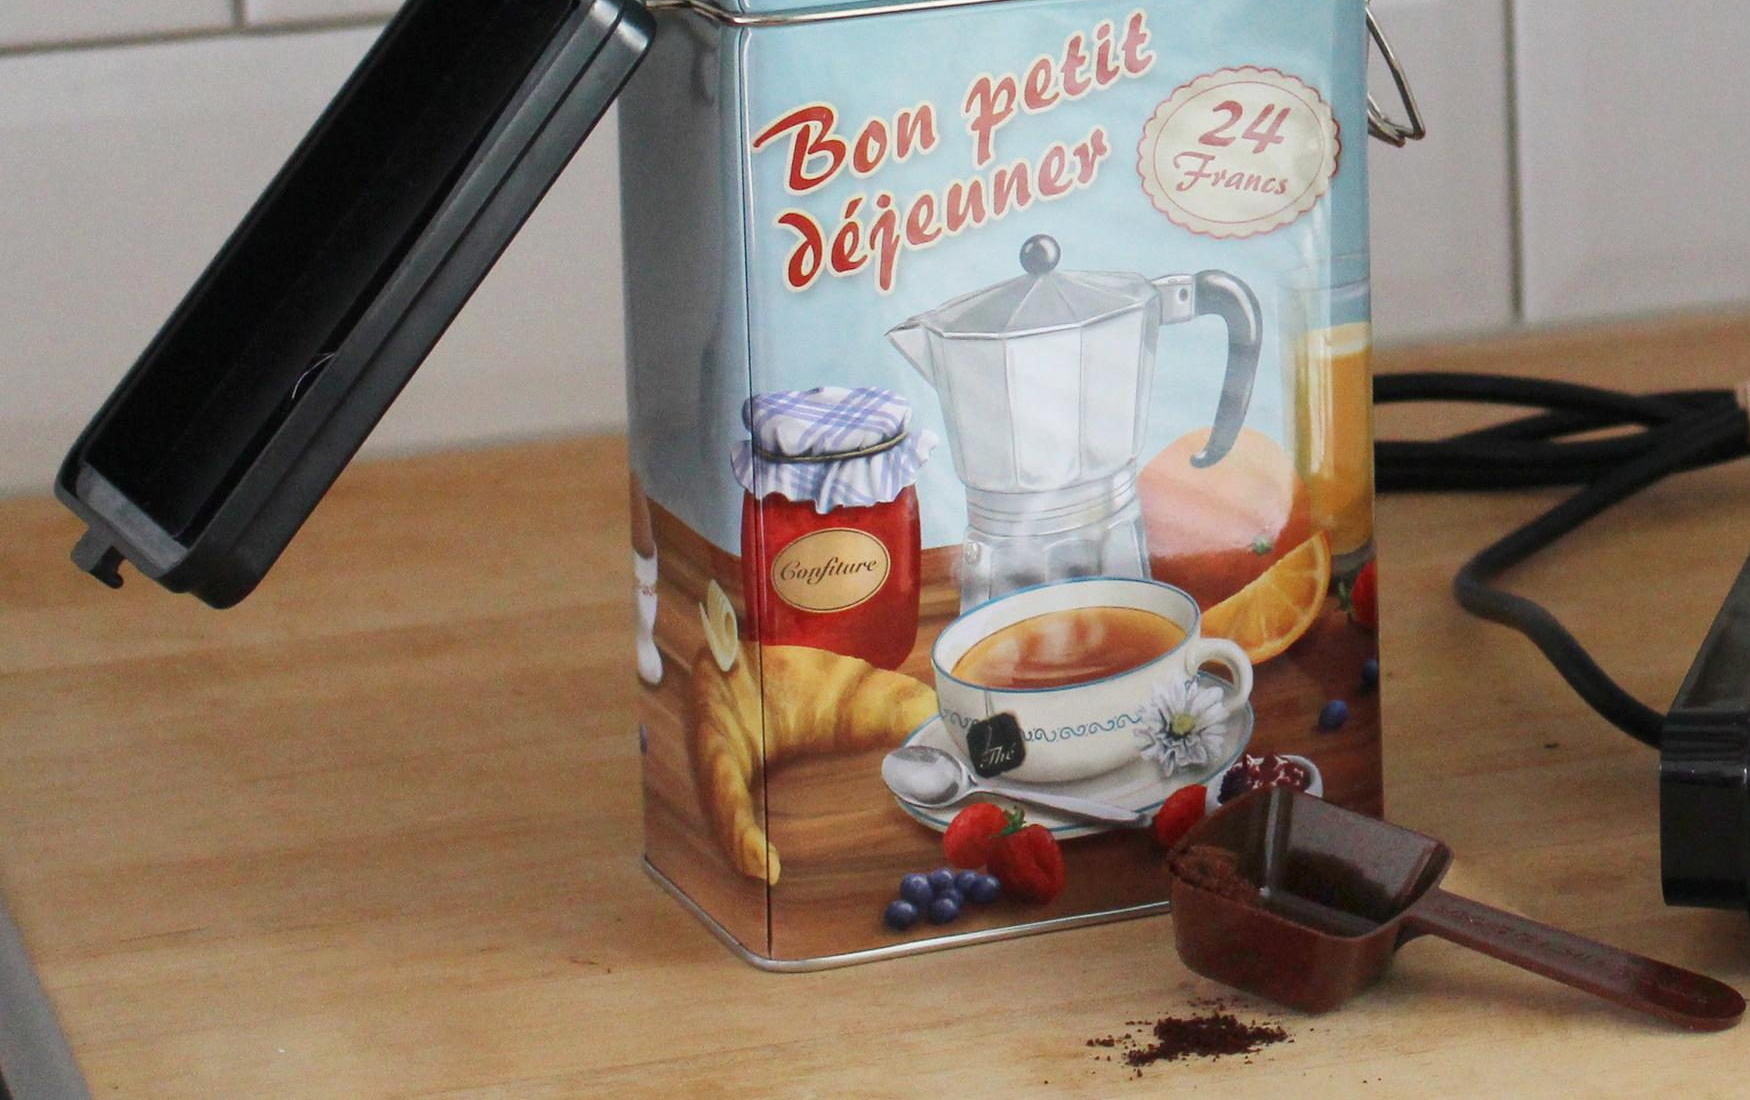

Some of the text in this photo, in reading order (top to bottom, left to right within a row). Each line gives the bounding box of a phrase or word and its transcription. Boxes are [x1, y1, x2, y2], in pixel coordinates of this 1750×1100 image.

[752, 11, 1154, 191] Bon petit
[1198, 99, 1292, 154] 24
[1173, 152, 1289, 196] Francs
[777, 128, 1108, 291] déjeuner
[780, 556, 877, 585] Confiture
